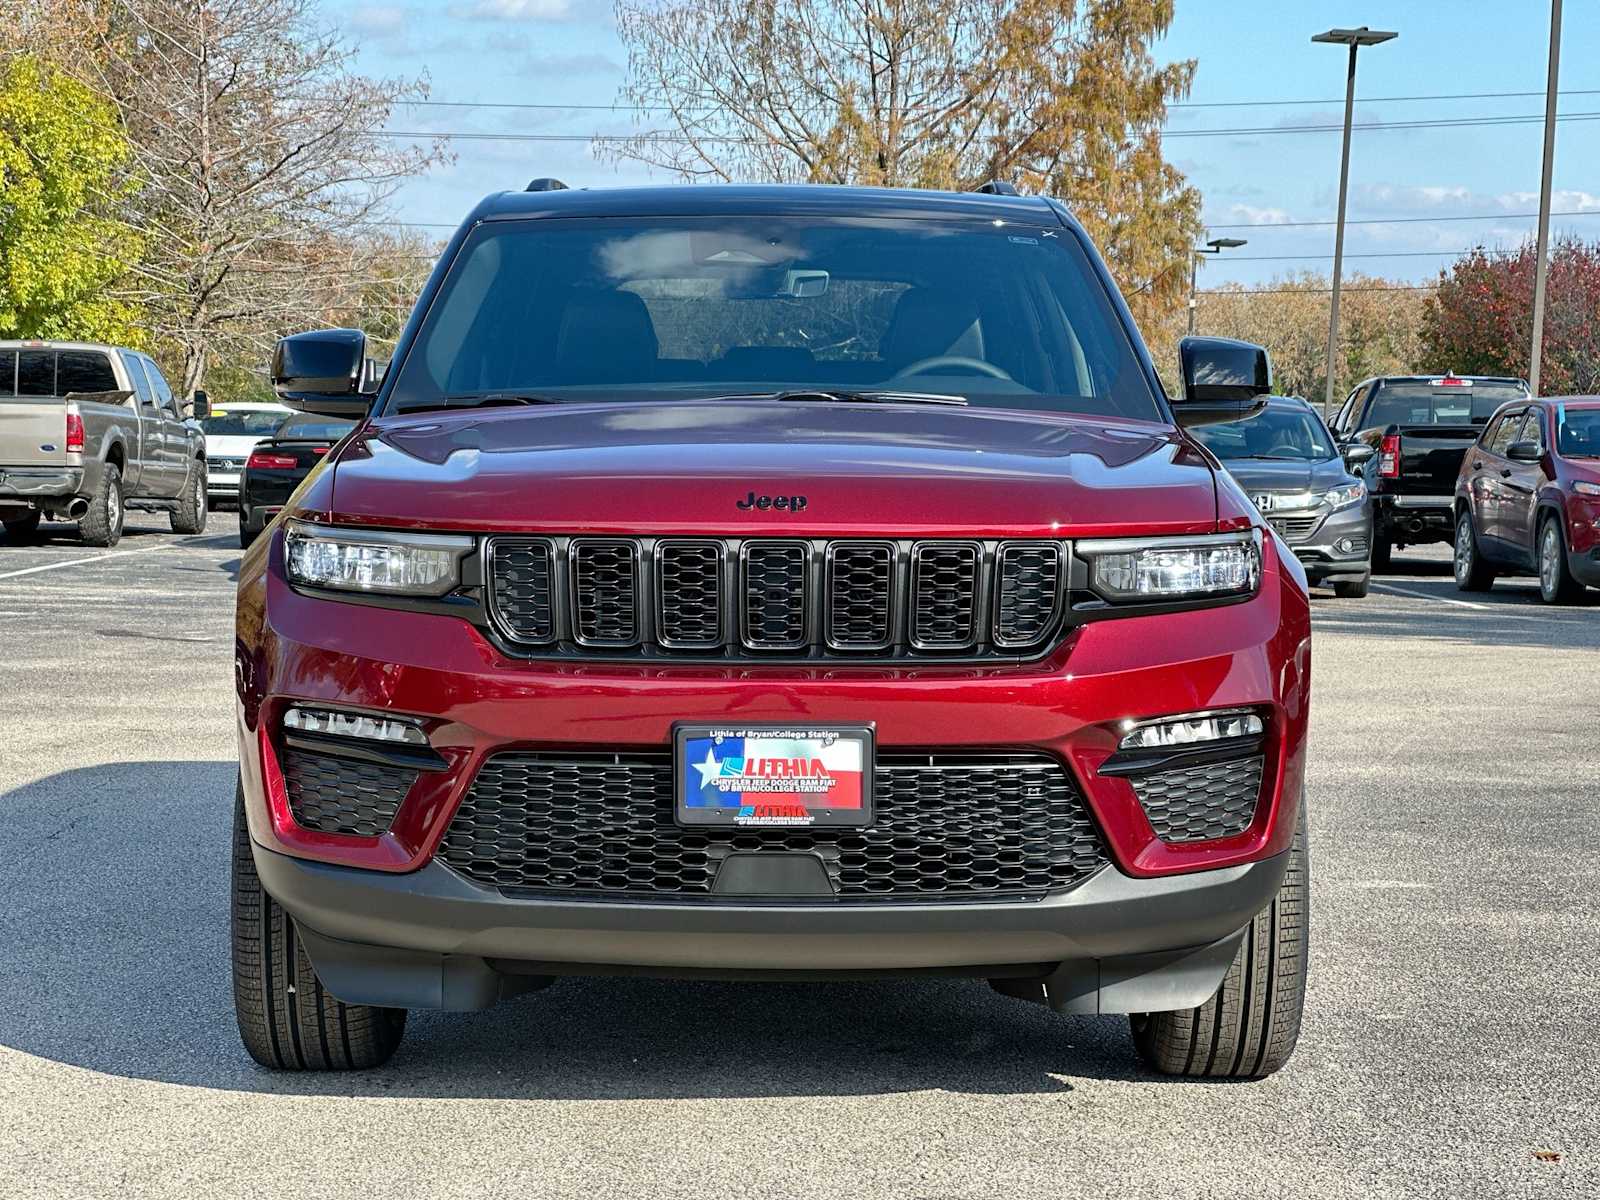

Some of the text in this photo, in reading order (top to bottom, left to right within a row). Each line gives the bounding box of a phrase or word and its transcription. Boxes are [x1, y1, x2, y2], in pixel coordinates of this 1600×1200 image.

[736, 492, 807, 512] Jeep
[709, 730, 734, 738] Lithia
[747, 730, 806, 739] Bryan/College
[807, 730, 840, 738] Station
[744, 758, 830, 778] LITHIA
[755, 805, 810, 816] LITHIA
